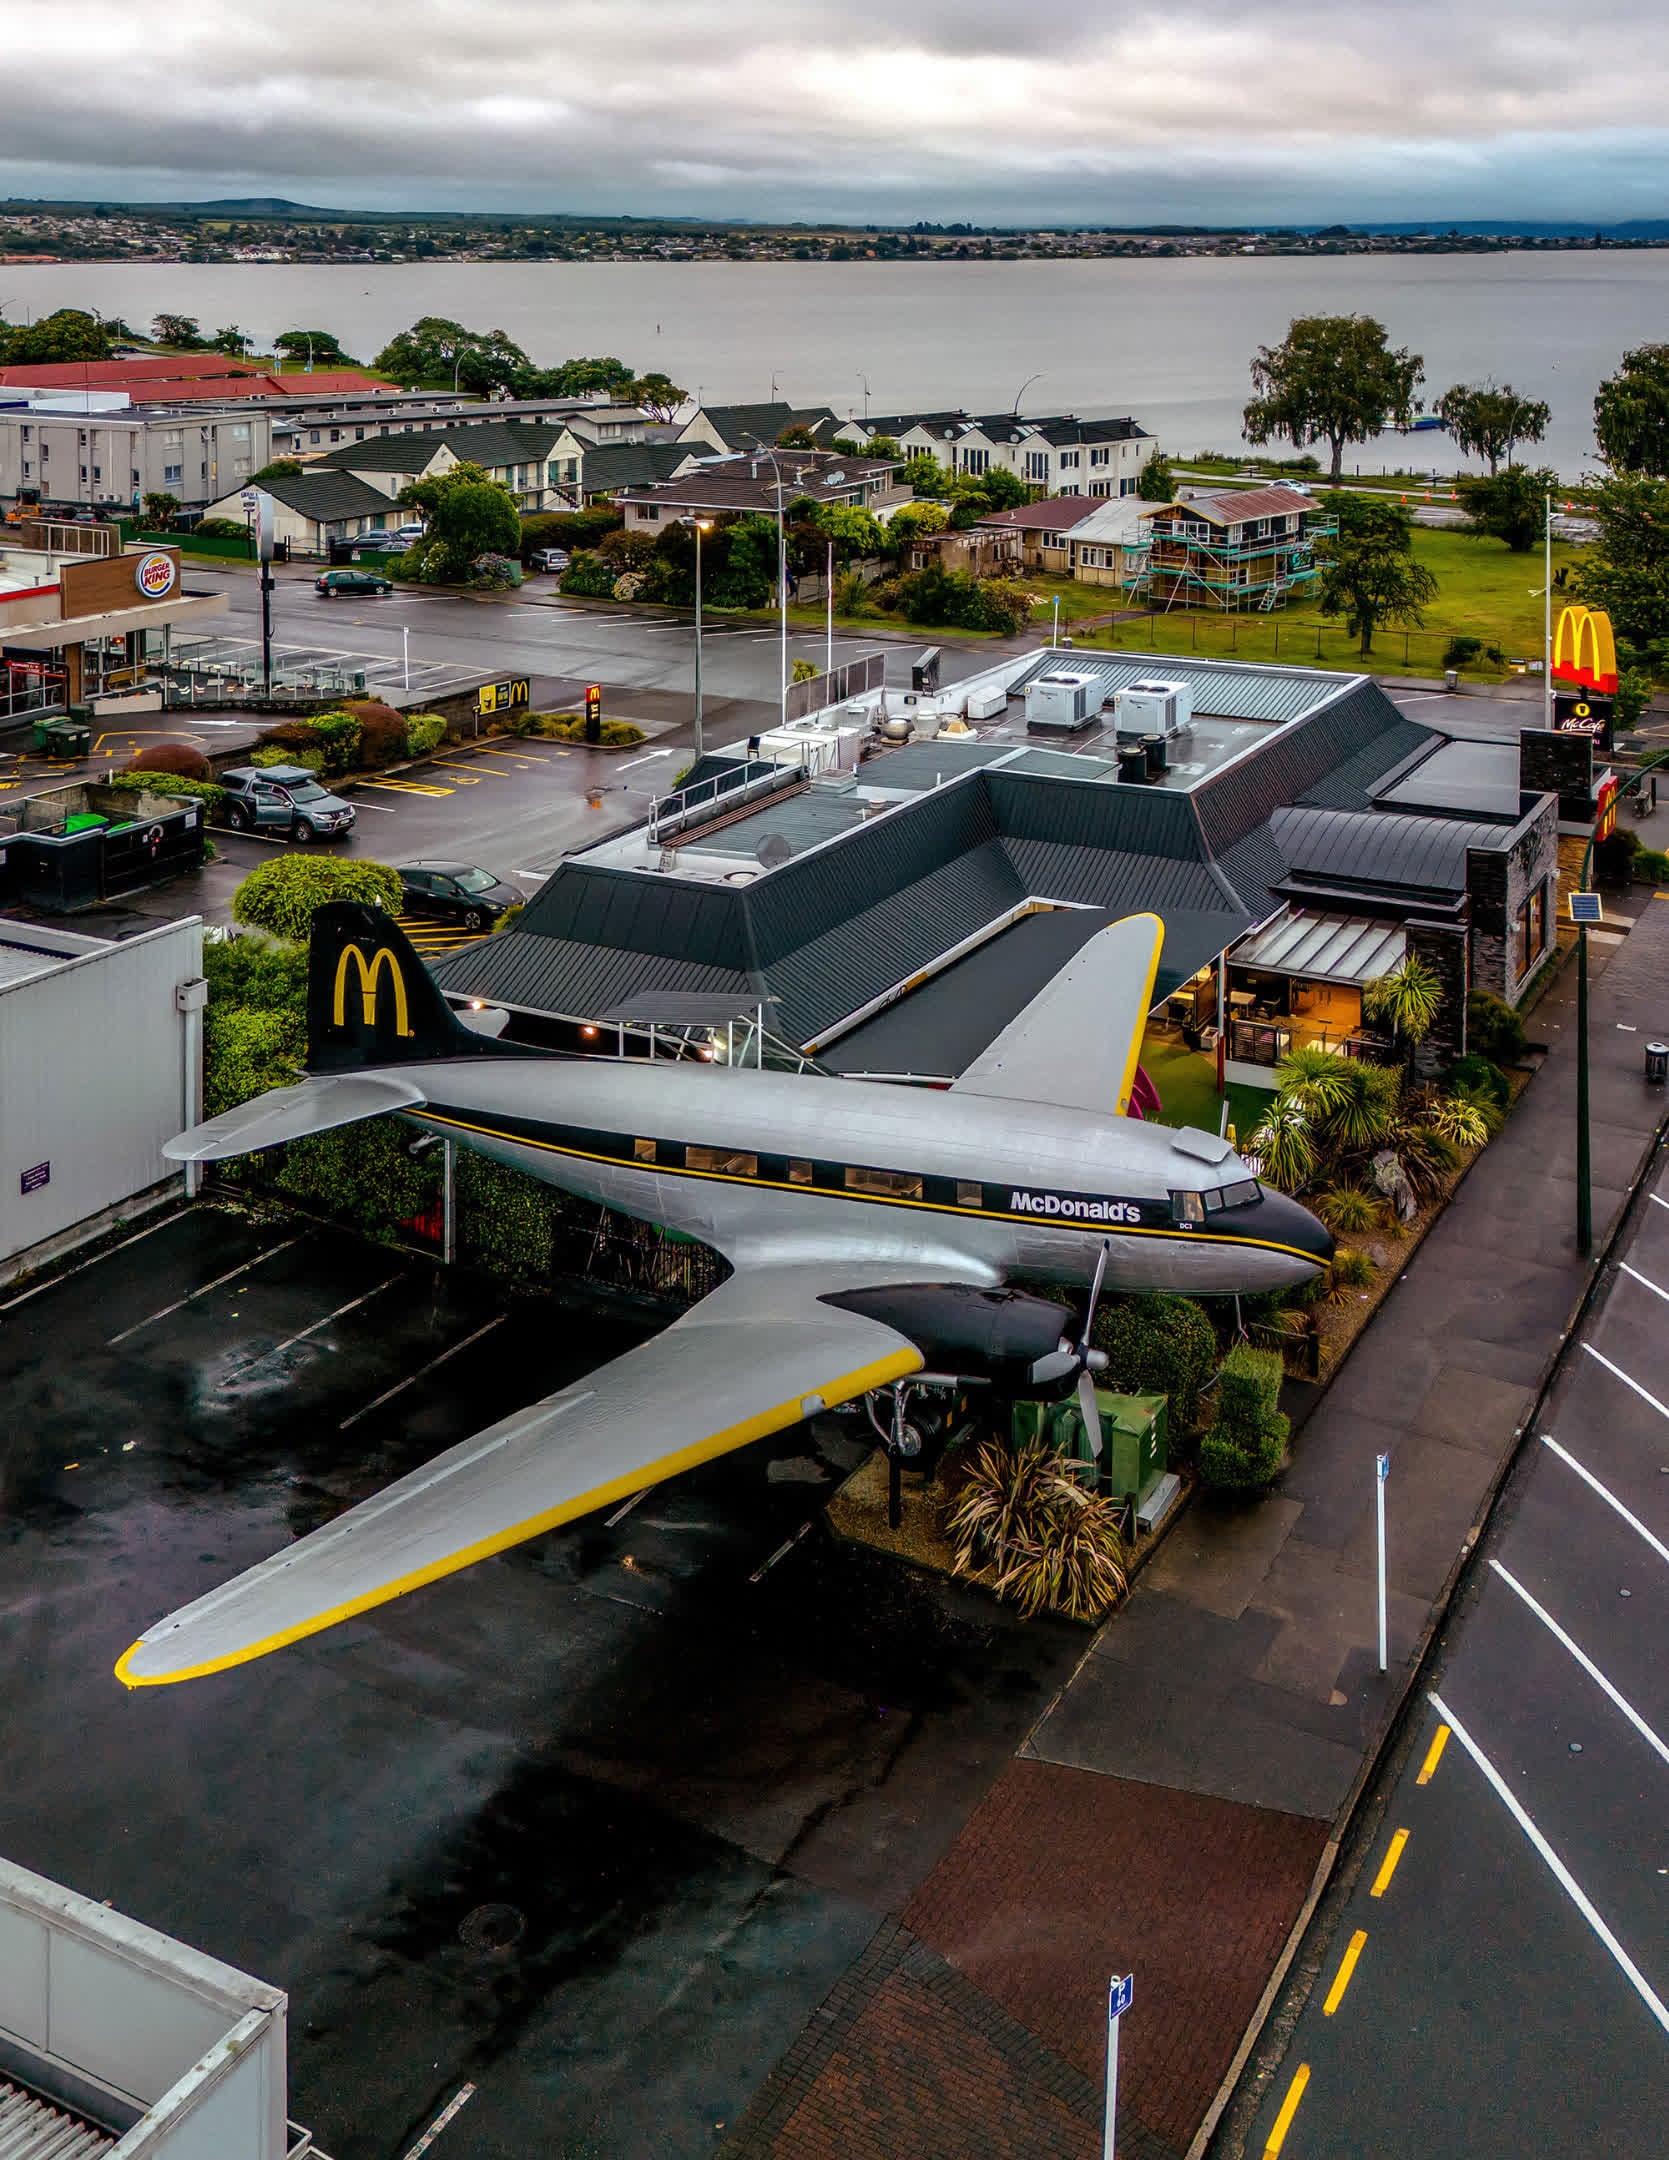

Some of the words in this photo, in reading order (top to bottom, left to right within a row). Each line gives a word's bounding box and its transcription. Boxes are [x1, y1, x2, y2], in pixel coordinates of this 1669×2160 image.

[144, 563, 170, 577] BURGER
[144, 570, 170, 587] KING
[1010, 1191, 1141, 1223] McDonald's
